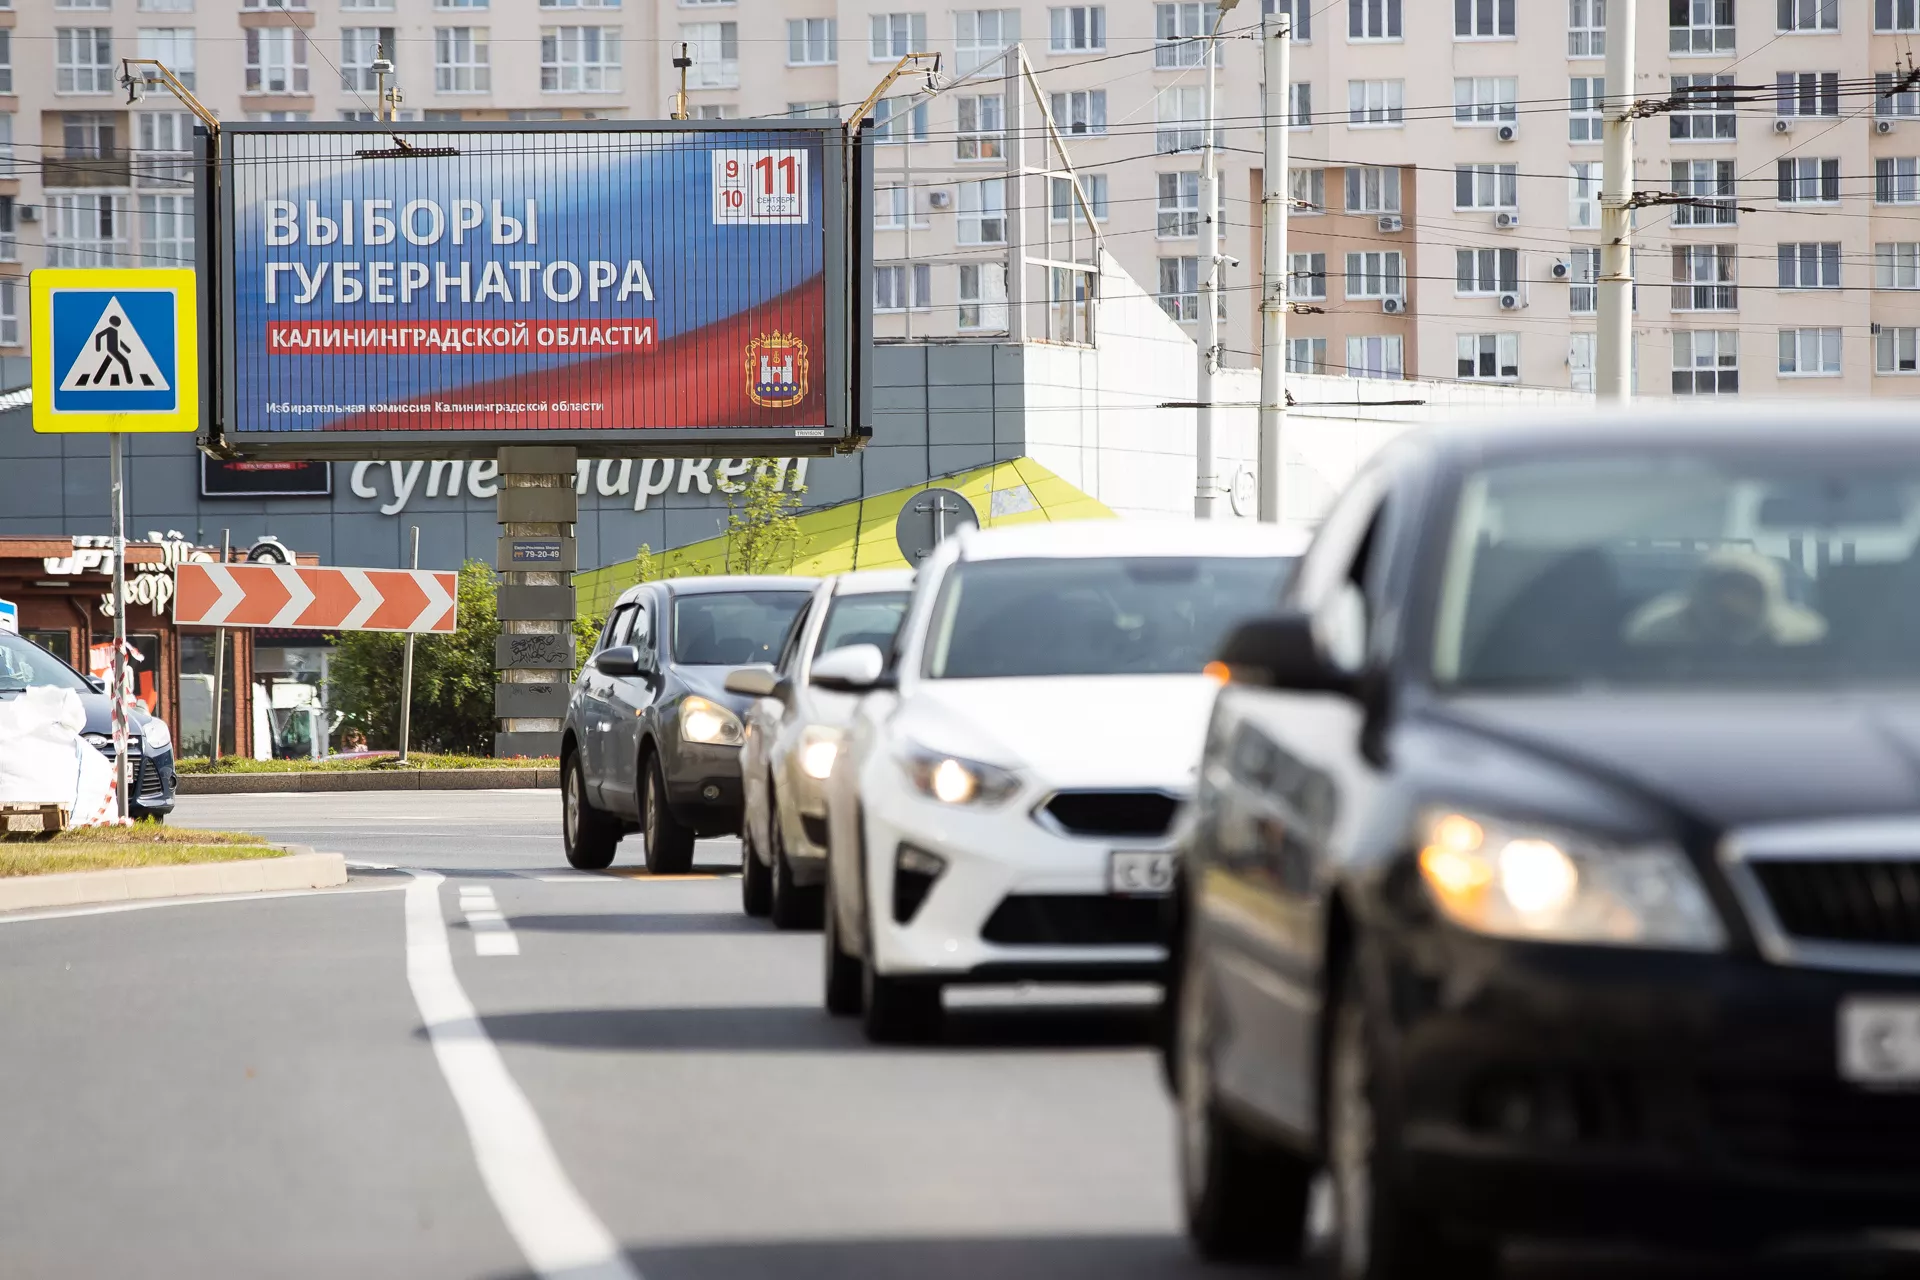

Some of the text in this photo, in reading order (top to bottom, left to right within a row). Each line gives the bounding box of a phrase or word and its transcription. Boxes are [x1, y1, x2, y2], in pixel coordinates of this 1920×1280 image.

[726, 160, 739, 178] 9
[755, 156, 795, 194] 11
[722, 190, 743, 207] 10
[756, 196, 796, 204] СЕНТЯБРЯ
[765, 204, 786, 212] 2022
[264, 198, 539, 246] ВЫБОРЫ
[264, 260, 656, 304] ГУБЕРНАТОРА
[272, 321, 652, 352] КАЛИНИНГРАДСКОЙ ОБЛАСТИ
[265, 401, 604, 415] Избирательная комиссия Калининградской области
[350, 458, 809, 516] супеаркет
